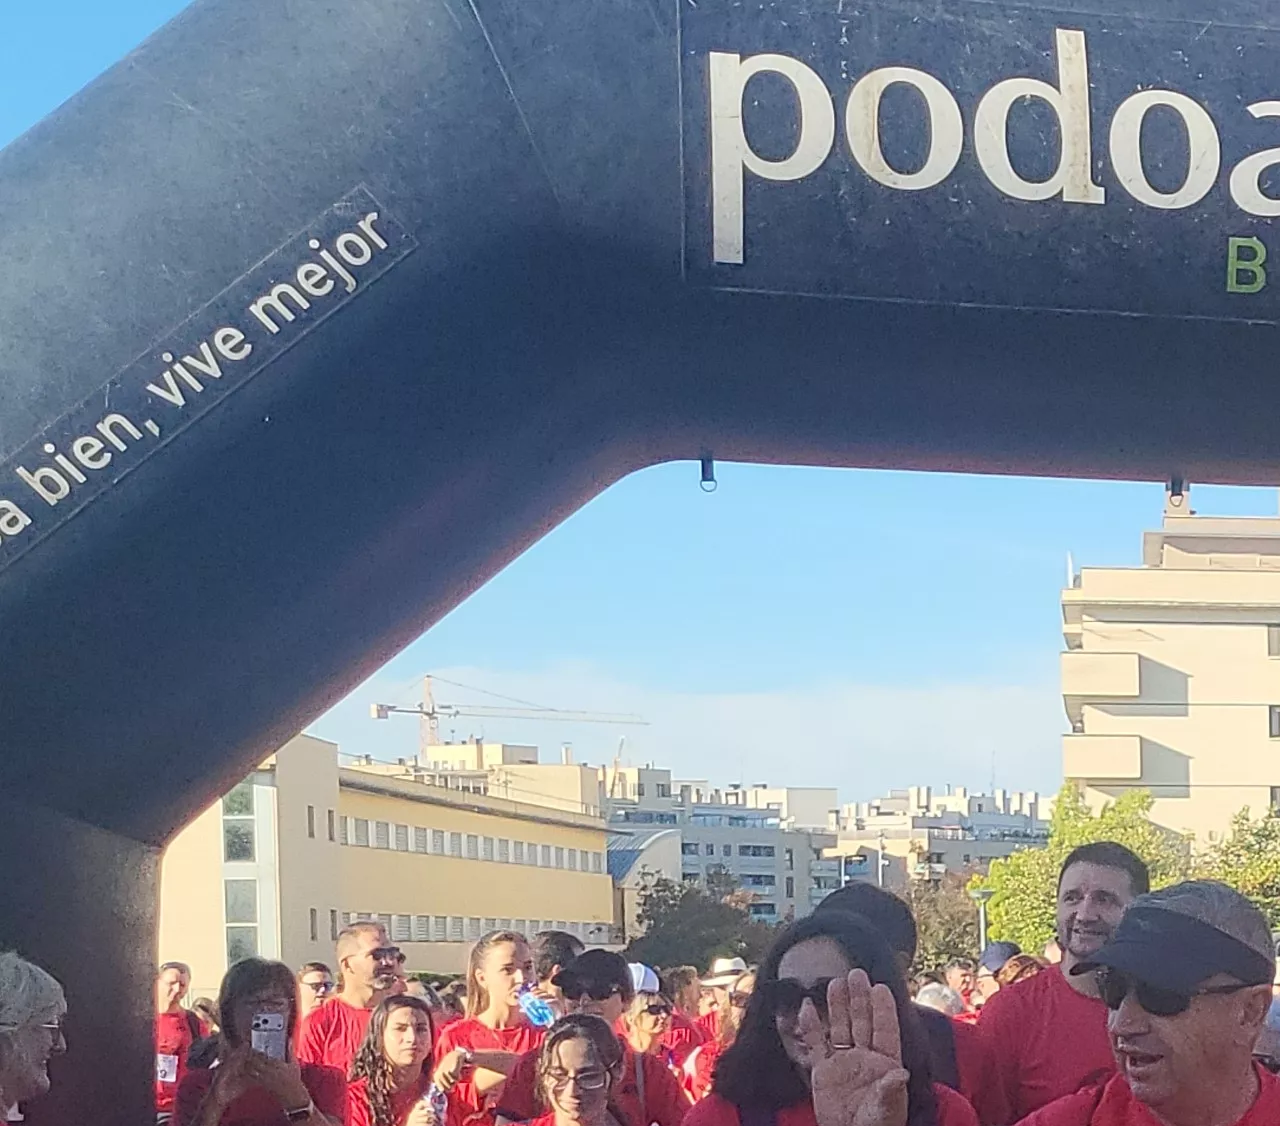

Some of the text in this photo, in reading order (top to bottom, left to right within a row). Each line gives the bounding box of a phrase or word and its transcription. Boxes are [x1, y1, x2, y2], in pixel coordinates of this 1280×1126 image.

[16, 410, 160, 505] bien,
[147, 325, 252, 408] vive
[249, 212, 388, 334] mejor
